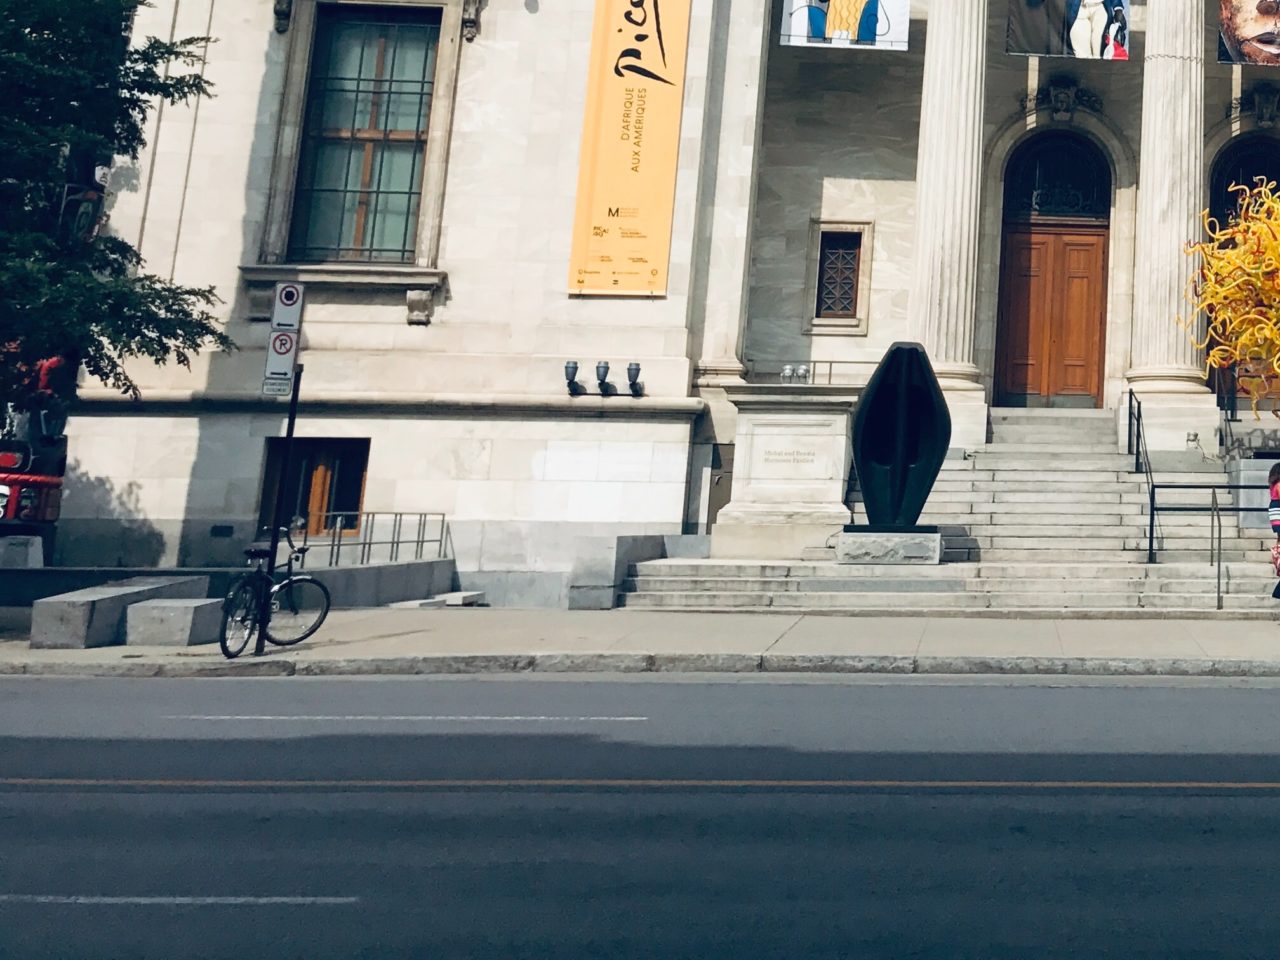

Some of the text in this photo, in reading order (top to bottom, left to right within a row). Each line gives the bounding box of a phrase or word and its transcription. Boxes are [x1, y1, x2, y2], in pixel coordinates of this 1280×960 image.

[631, 88, 647, 173] AUX AMÉRIQUES
[608, 207, 619, 217] M
